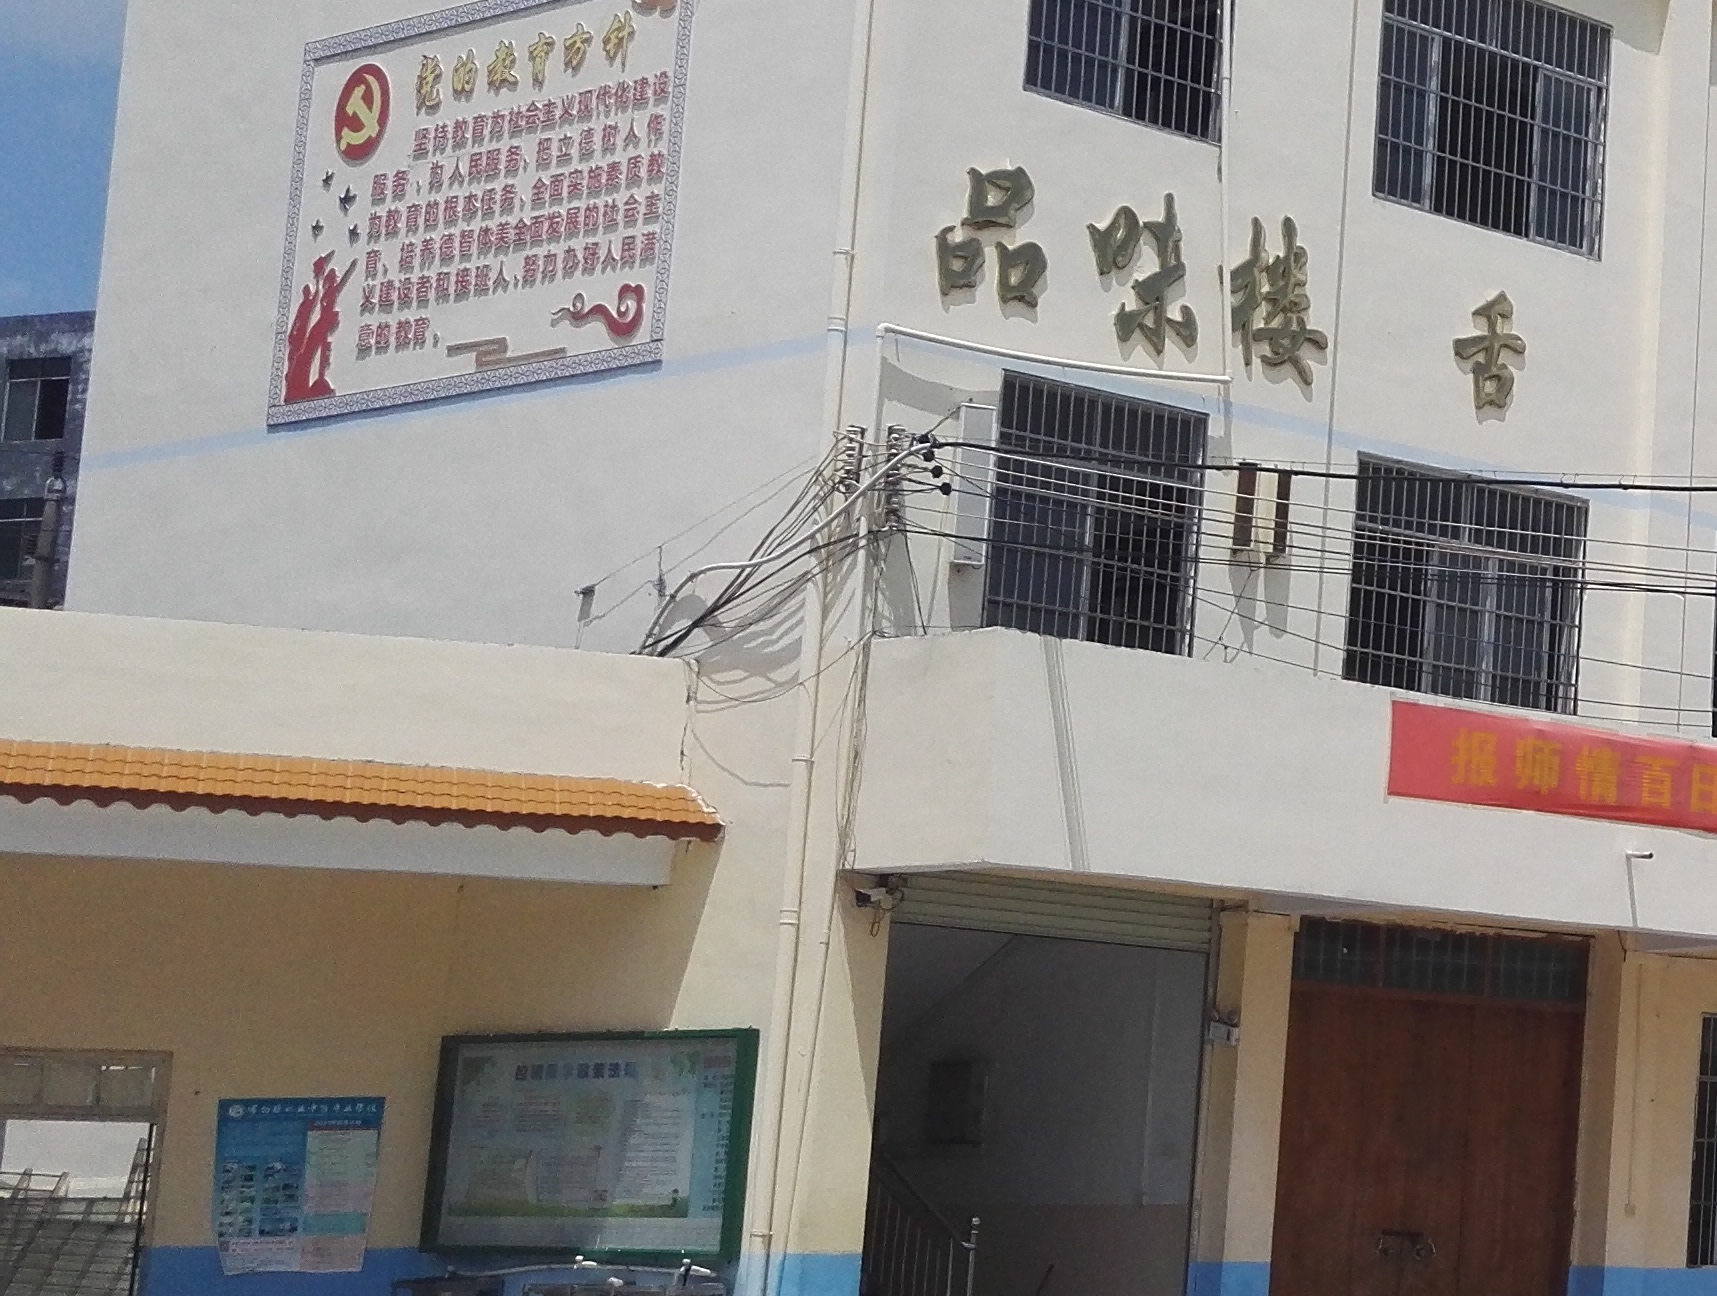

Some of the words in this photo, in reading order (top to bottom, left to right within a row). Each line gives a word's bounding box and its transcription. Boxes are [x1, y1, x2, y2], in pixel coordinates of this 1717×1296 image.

[415, 10, 636, 110] 党的教育方针
[412, 71, 671, 153] 坚持教育为社会主义现代化建设
[935, 165, 1327, 387] 品味楼
